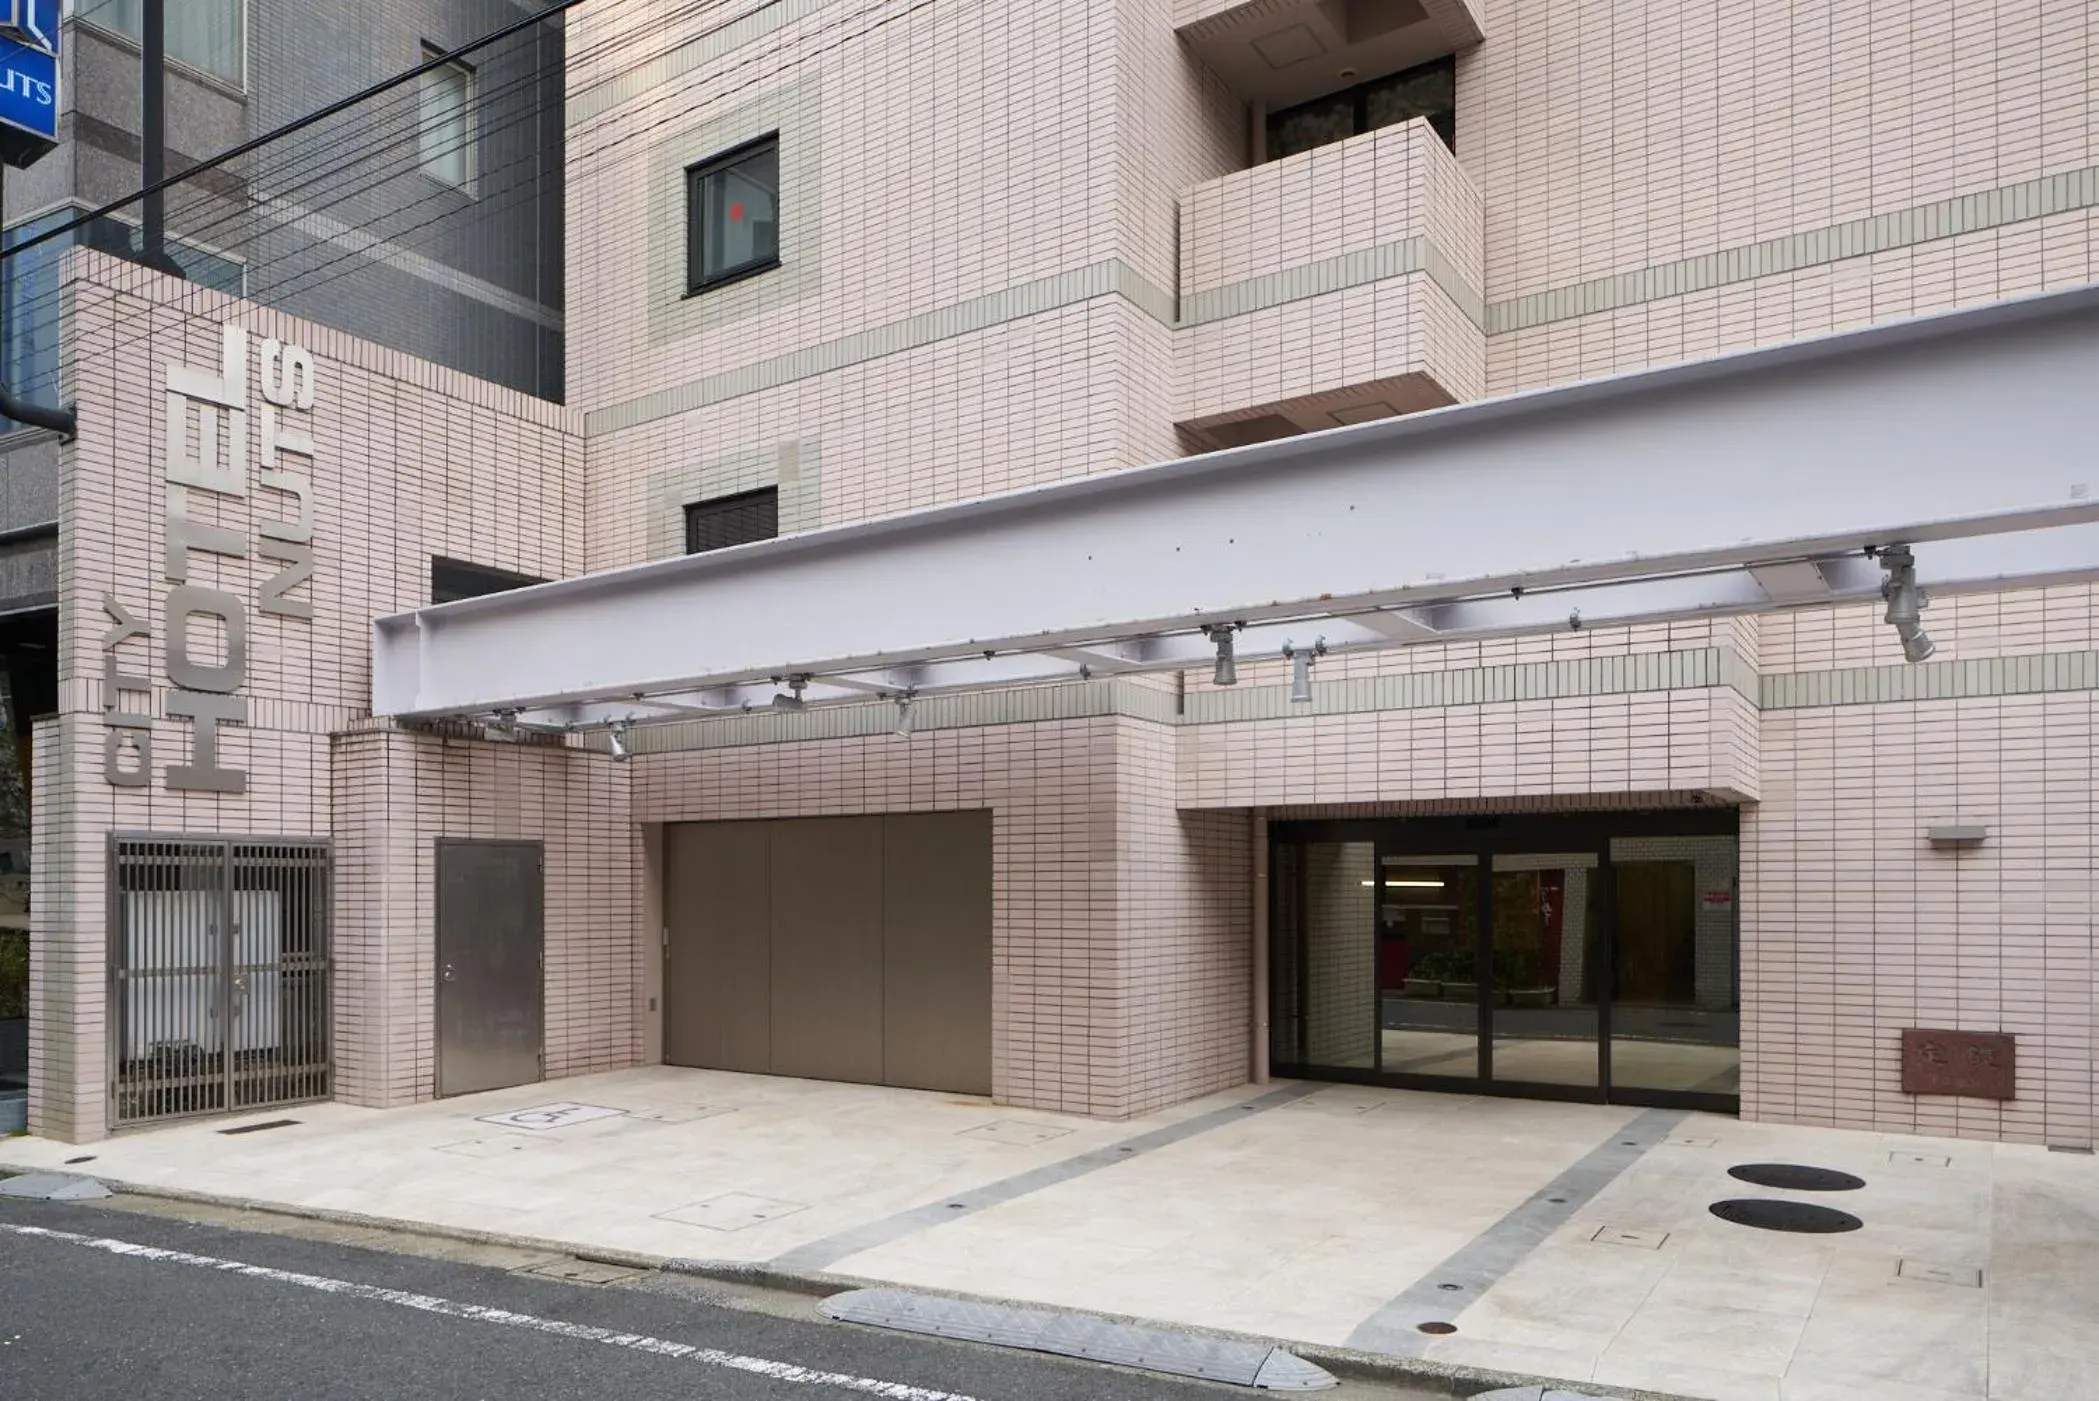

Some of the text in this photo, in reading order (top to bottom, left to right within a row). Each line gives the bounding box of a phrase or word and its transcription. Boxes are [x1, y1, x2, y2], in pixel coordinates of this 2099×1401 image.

[165, 324, 247, 795] HOTEL
[258, 337, 315, 620] NUTS
[102, 590, 150, 788] CITY
